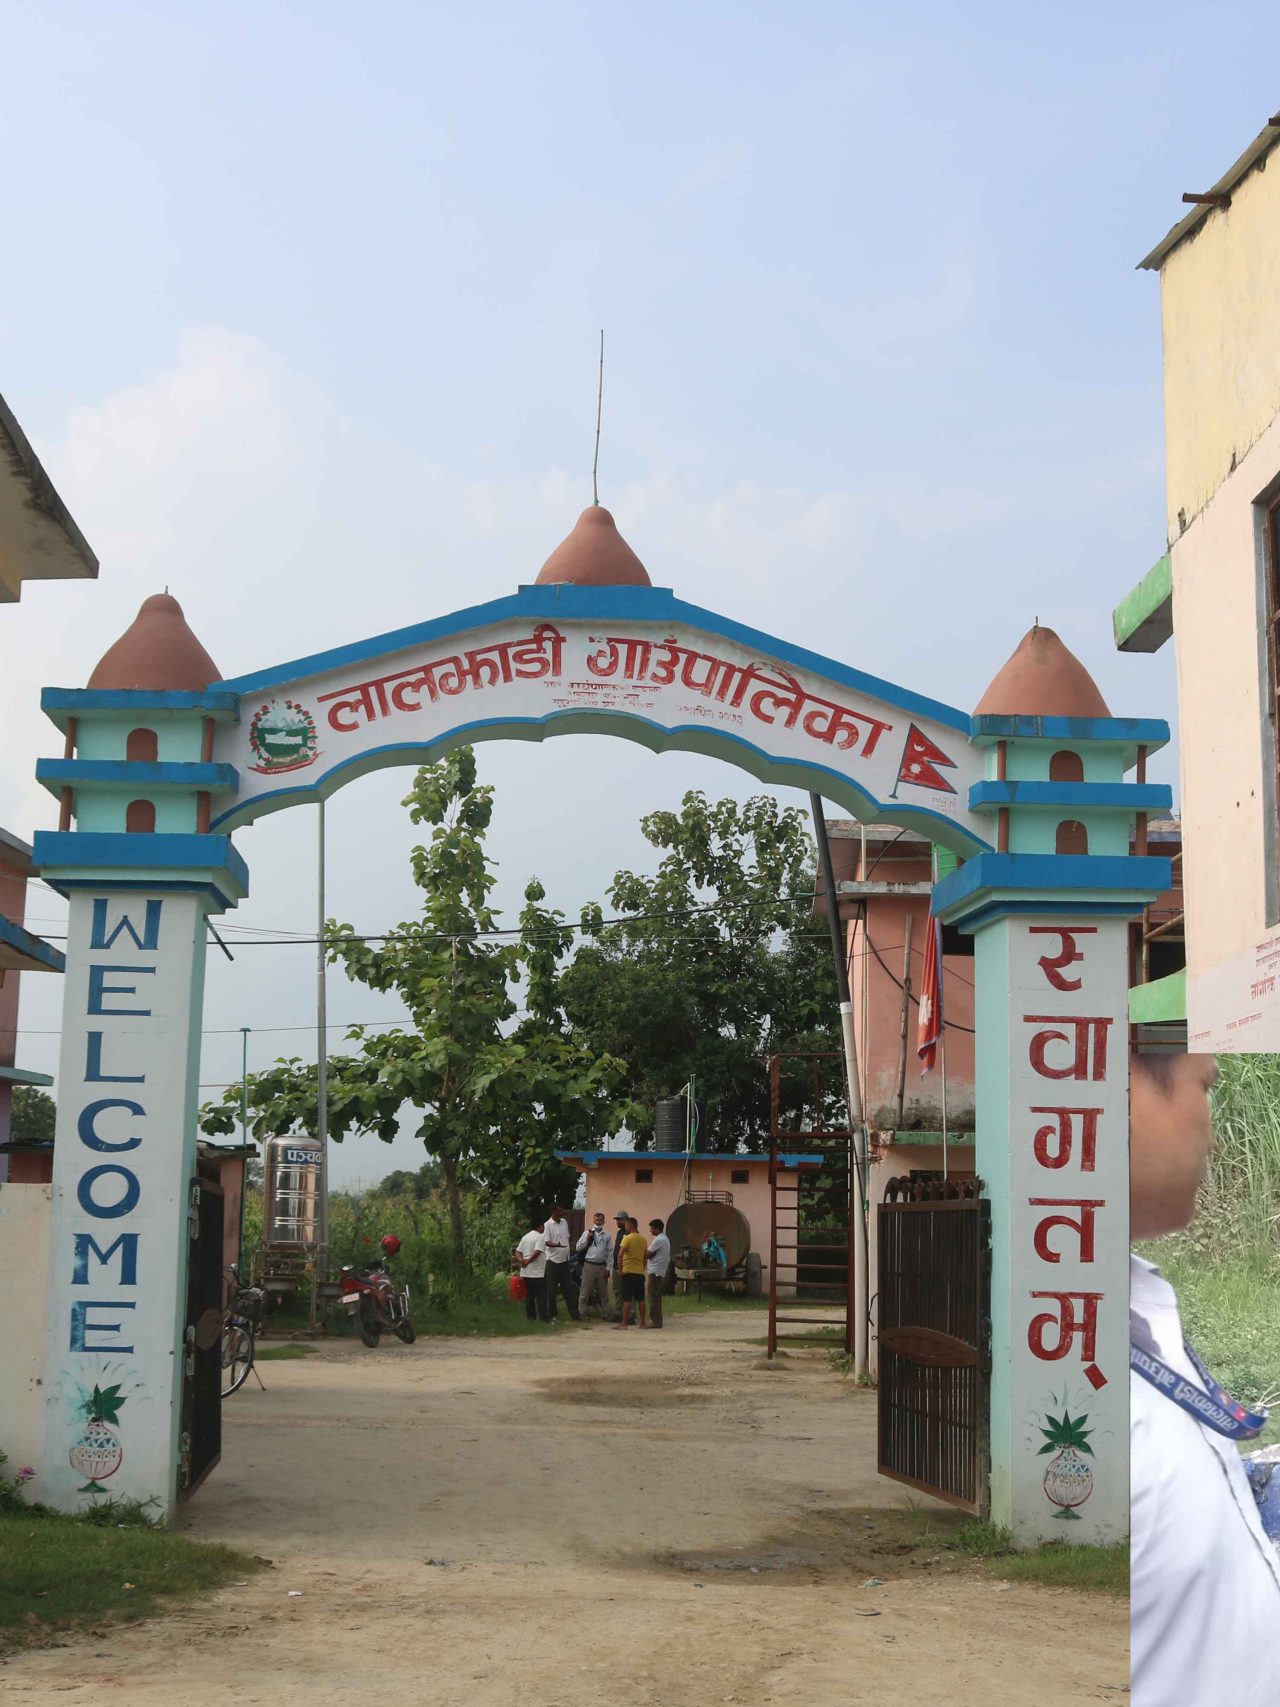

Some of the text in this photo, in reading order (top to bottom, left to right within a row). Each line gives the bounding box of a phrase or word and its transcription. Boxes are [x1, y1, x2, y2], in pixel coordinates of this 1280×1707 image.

[316, 624, 893, 760] लालझाडी गाउँपालिका
[69, 898, 163, 1354] WELCOME
